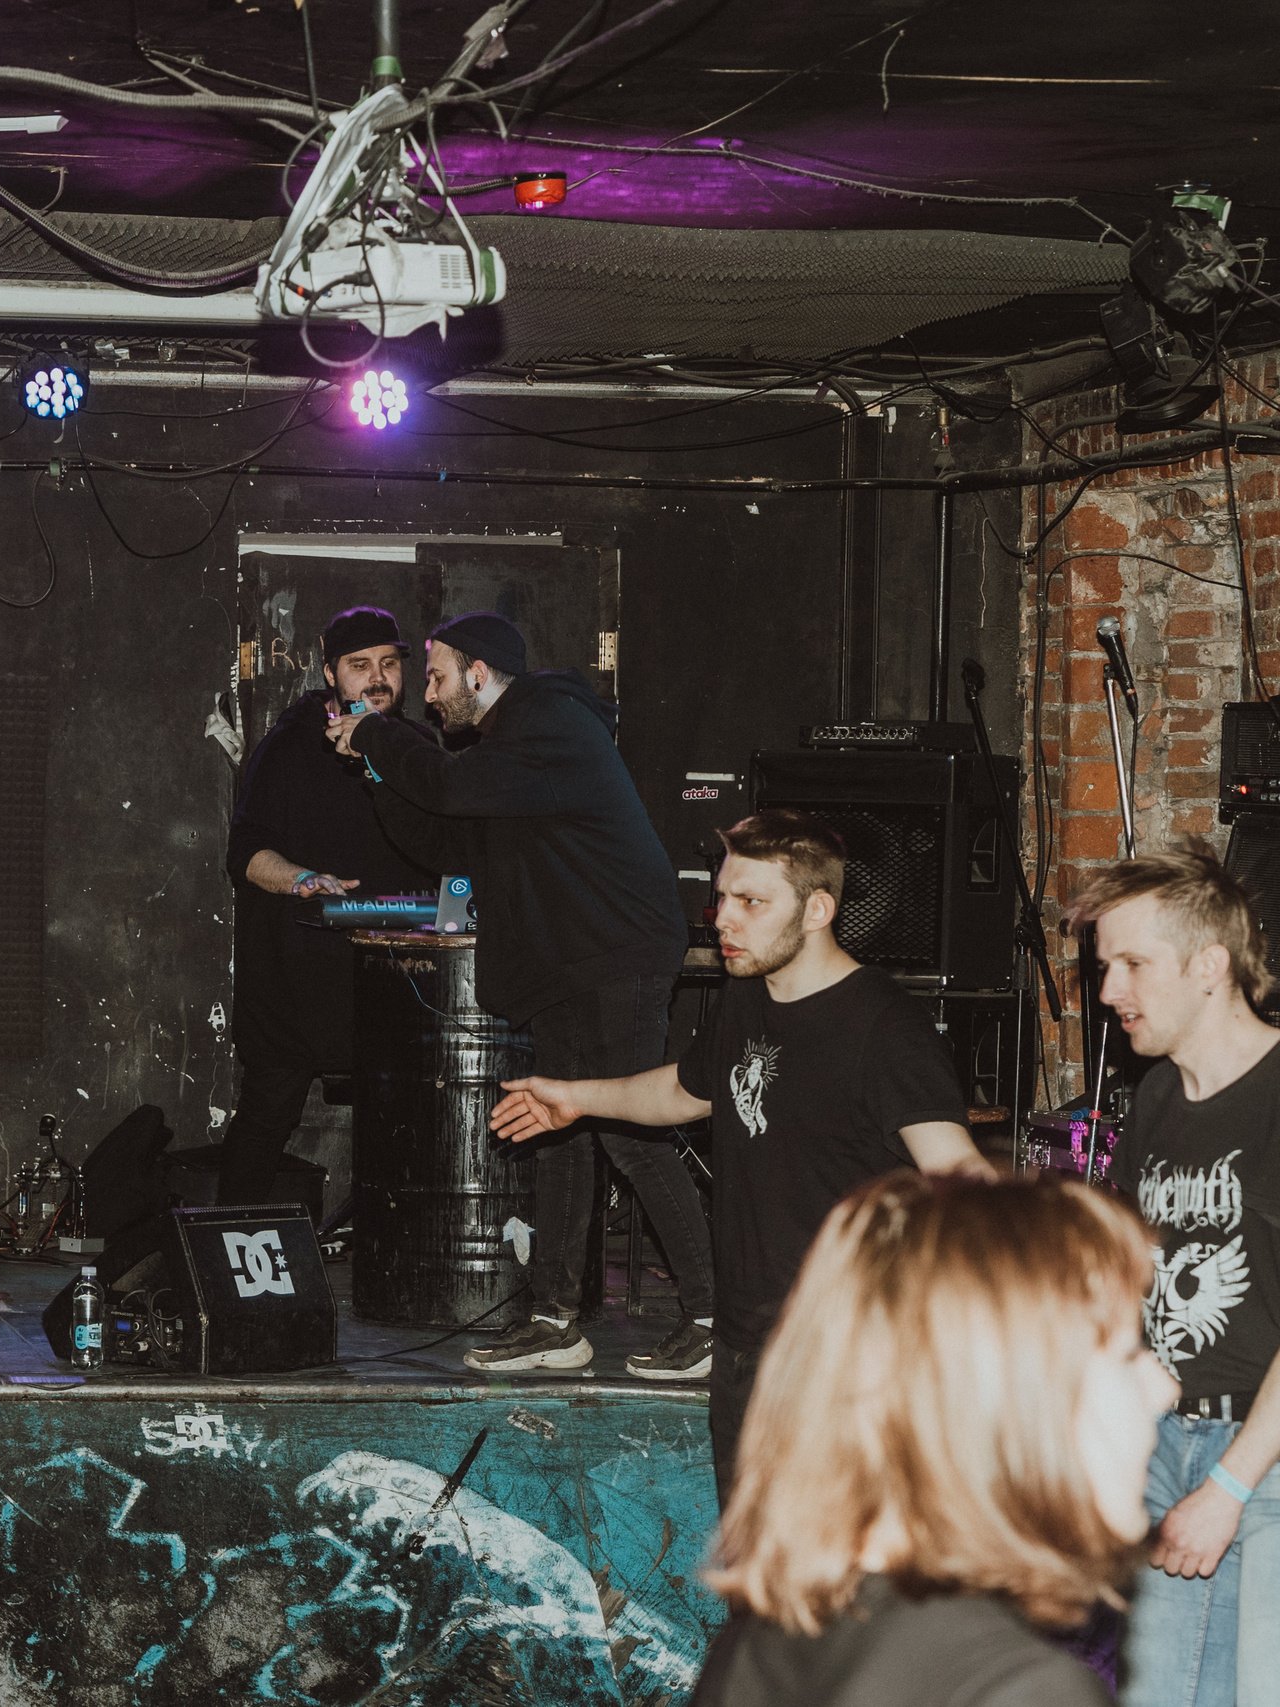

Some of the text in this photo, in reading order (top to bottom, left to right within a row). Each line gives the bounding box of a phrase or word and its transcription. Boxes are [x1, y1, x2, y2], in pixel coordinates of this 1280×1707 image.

[683, 786, 718, 799] ataka
[341, 900, 417, 911] M-AUDIO
[222, 1229, 296, 1298] DC
